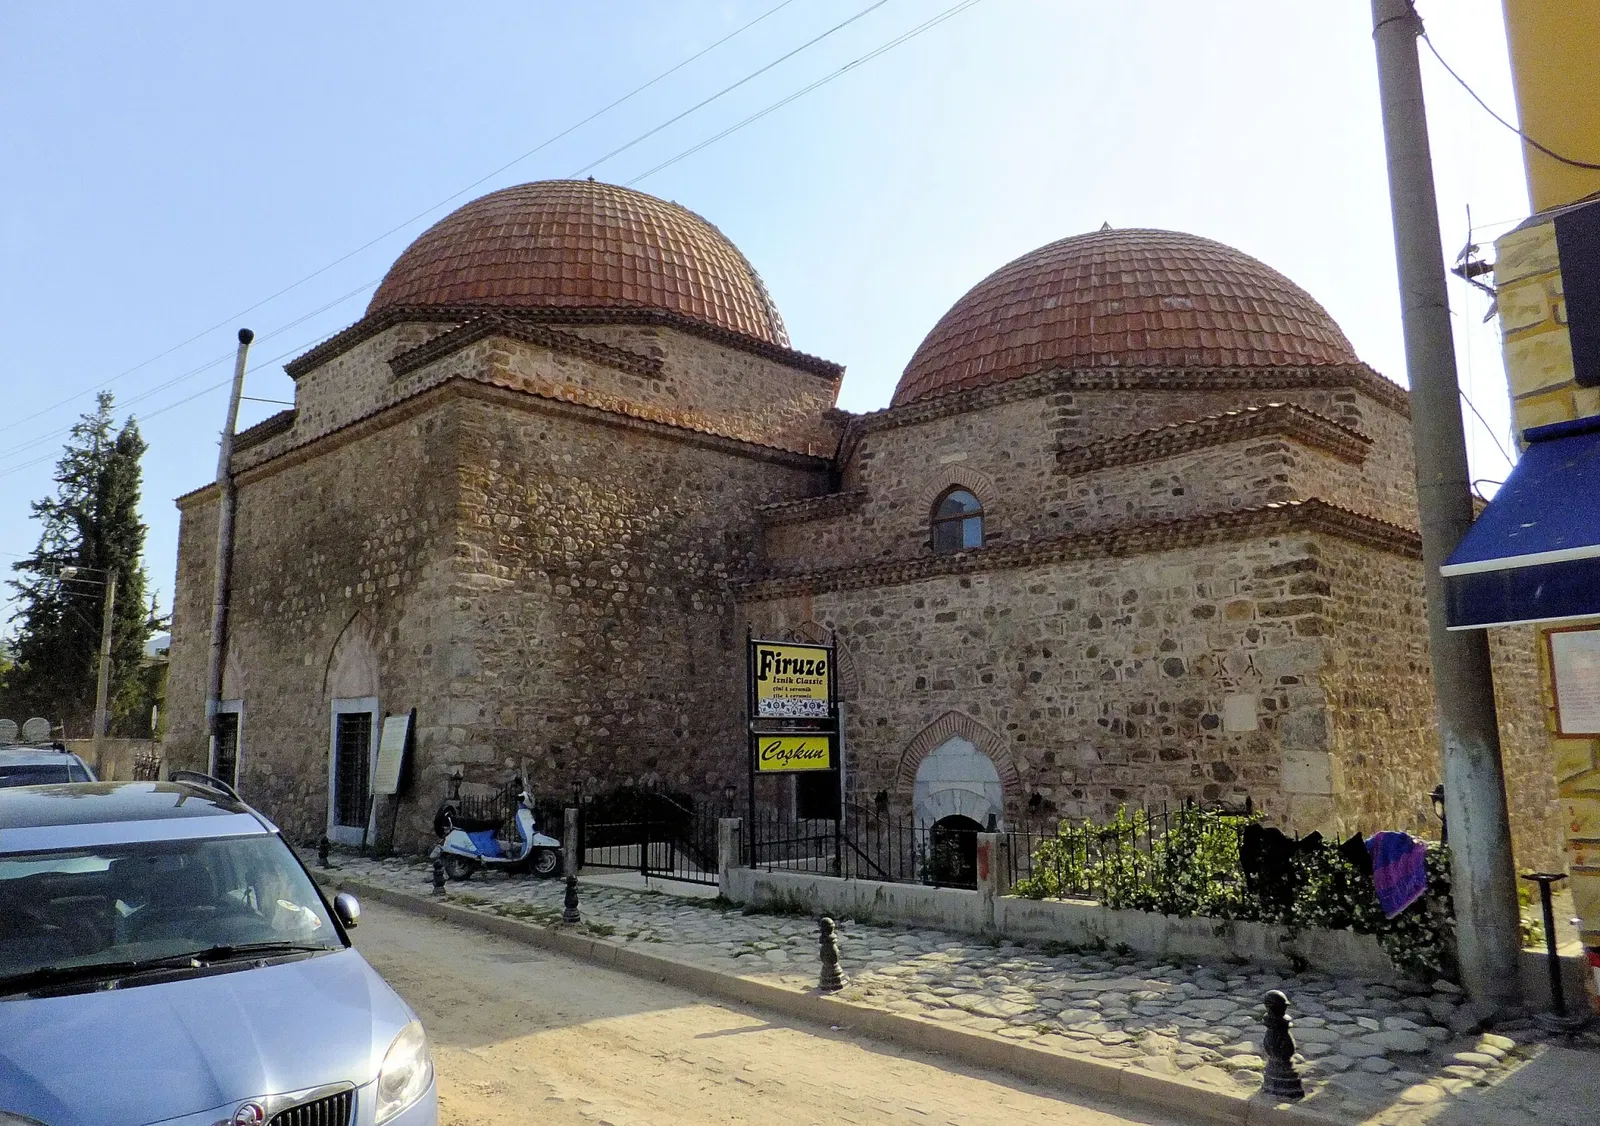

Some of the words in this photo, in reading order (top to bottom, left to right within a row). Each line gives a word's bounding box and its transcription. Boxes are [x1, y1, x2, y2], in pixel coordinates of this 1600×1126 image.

[758, 649, 826, 681] Firuze
[796, 677, 823, 685] Classic
[761, 740, 826, 766] Coşkun
